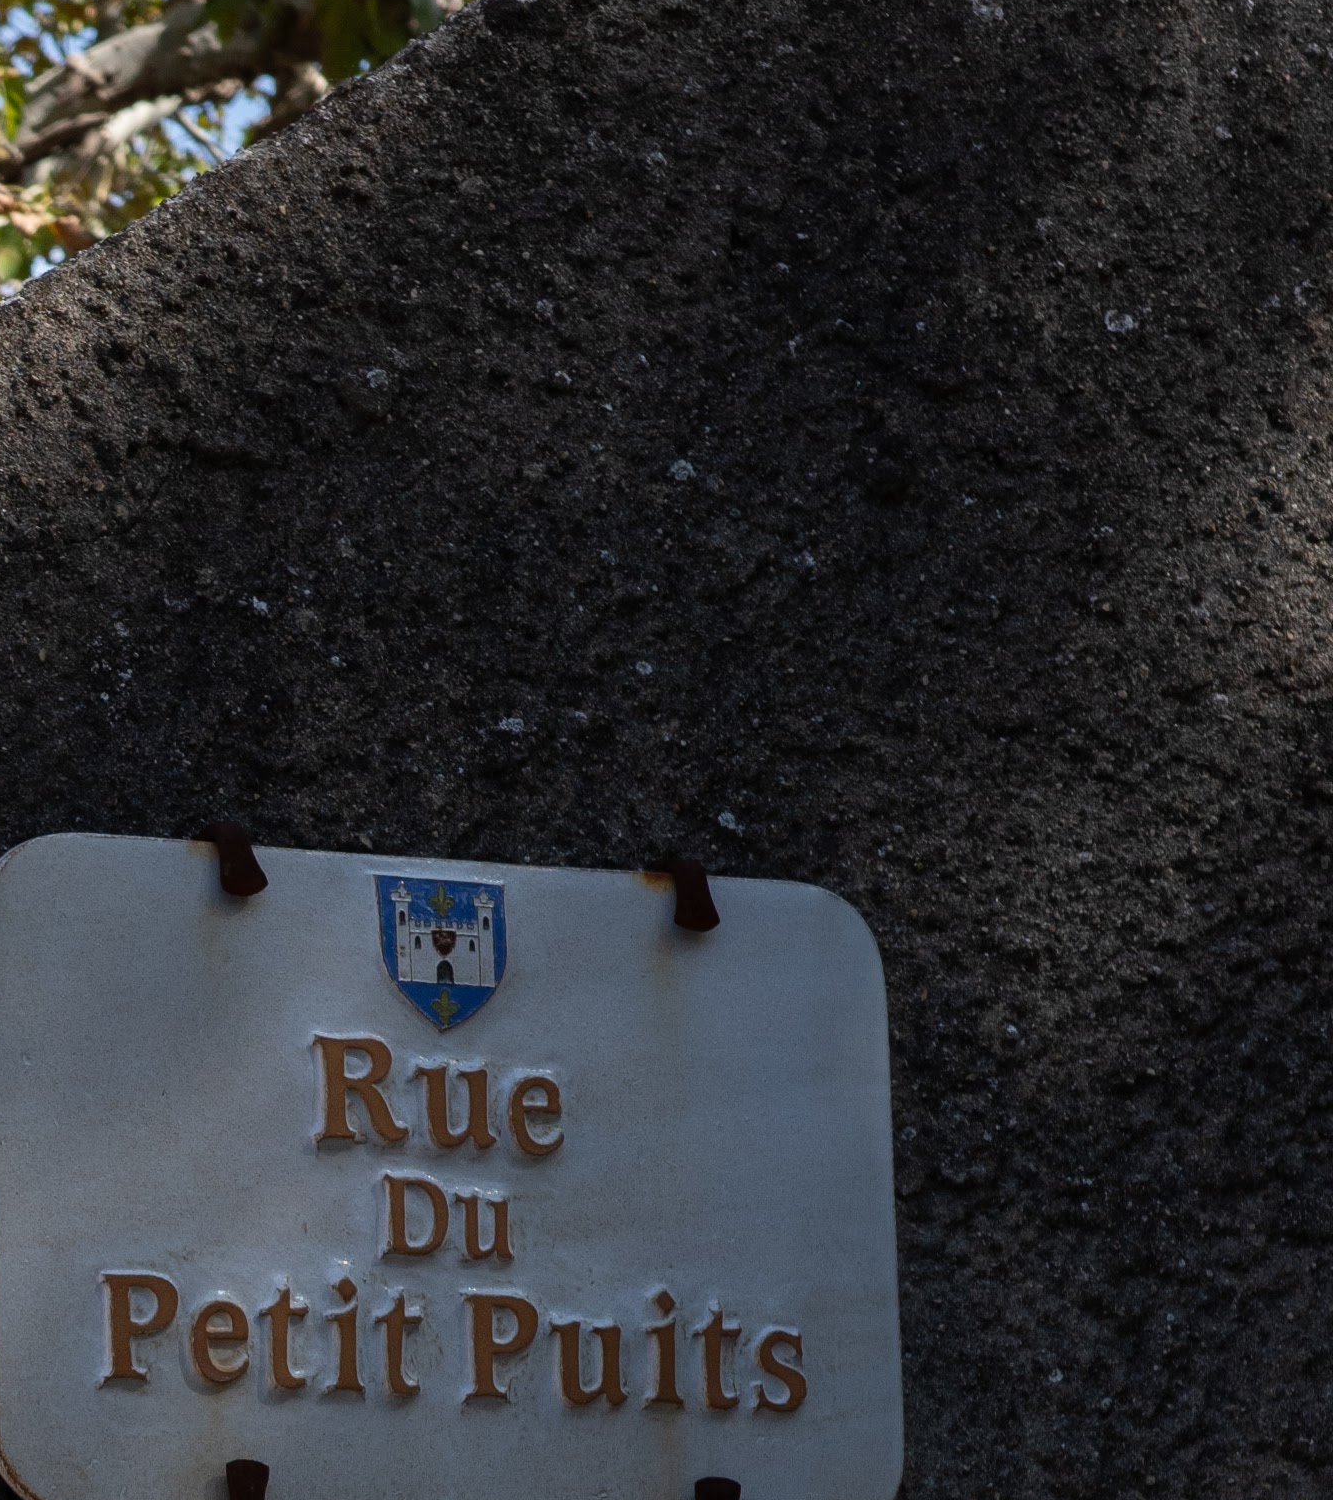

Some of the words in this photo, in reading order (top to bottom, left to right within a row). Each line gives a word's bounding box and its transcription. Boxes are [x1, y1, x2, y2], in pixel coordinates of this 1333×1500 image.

[313, 1033, 565, 1156] Rue
[383, 1173, 515, 1261] Du
[100, 1272, 423, 1396] Petit
[464, 1289, 807, 1413] Puits
